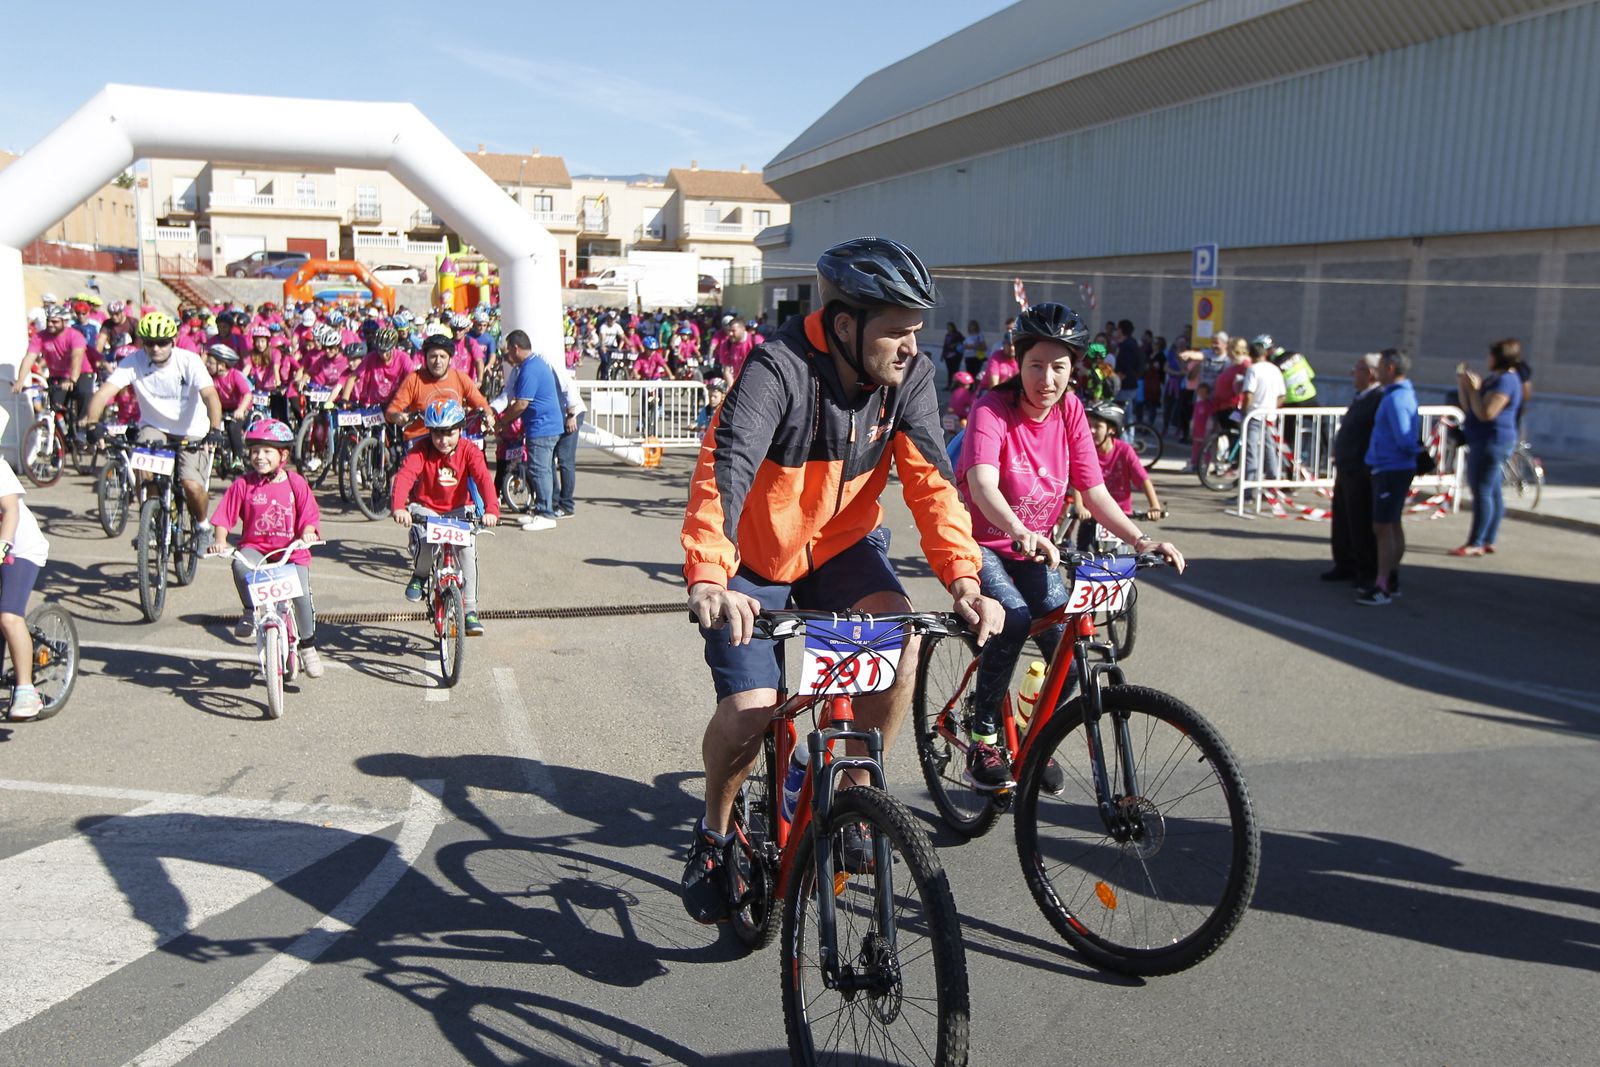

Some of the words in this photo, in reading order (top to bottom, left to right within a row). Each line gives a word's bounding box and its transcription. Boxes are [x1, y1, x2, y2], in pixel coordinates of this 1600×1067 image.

[1196, 249, 1211, 283] P
[341, 415, 359, 424] 505
[365, 415, 382, 425] 504
[136, 455, 165, 469] 011
[432, 527, 464, 542] 548
[257, 580, 293, 602] 569
[1073, 584, 1121, 608] 301
[810, 656, 881, 689] 391
